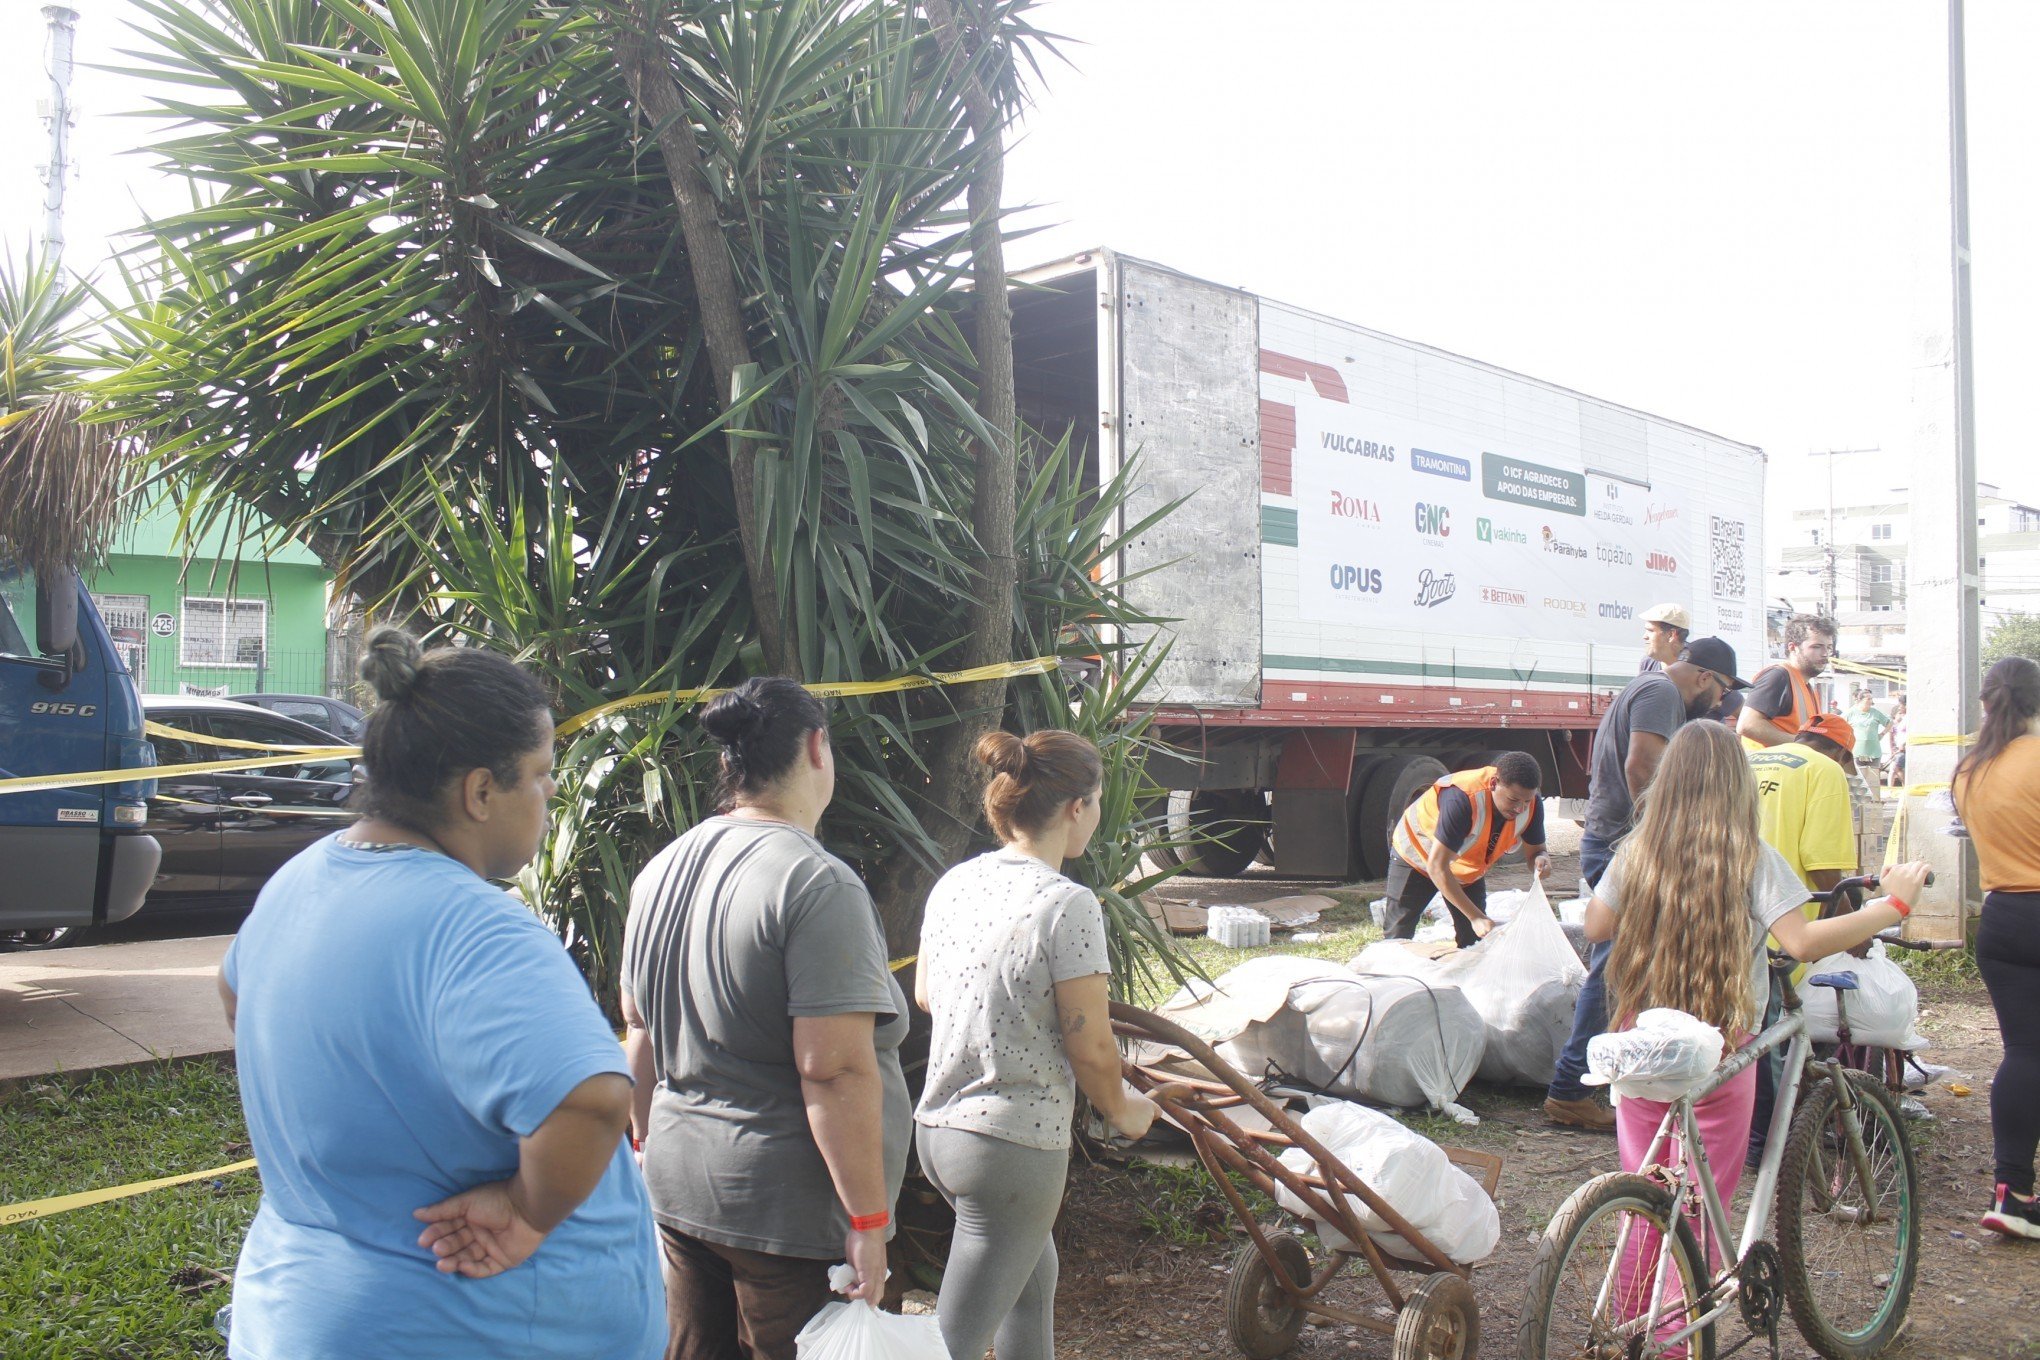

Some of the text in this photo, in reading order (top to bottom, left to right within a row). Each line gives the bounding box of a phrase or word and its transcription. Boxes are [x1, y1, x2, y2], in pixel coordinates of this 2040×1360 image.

[1320, 431, 1395, 462] VULCABRAS
[1415, 454, 1467, 476] TRAMONTINA
[1503, 465, 1569, 489] O ICF AGRADECE O
[1497, 481, 1577, 507] APOIO DAS EMPRESAS:
[1330, 490, 1381, 522] ROMA
[1415, 502, 1450, 537] GNC
[1493, 527, 1527, 544] vakinha
[1553, 542, 1588, 559] Parahyba
[1645, 552, 1677, 573] JIMO
[1330, 564, 1383, 594] OPUS
[1491, 589, 1525, 605] BETTANIN
[1598, 600, 1633, 620] ambev
[31, 702, 97, 717] 915 C
